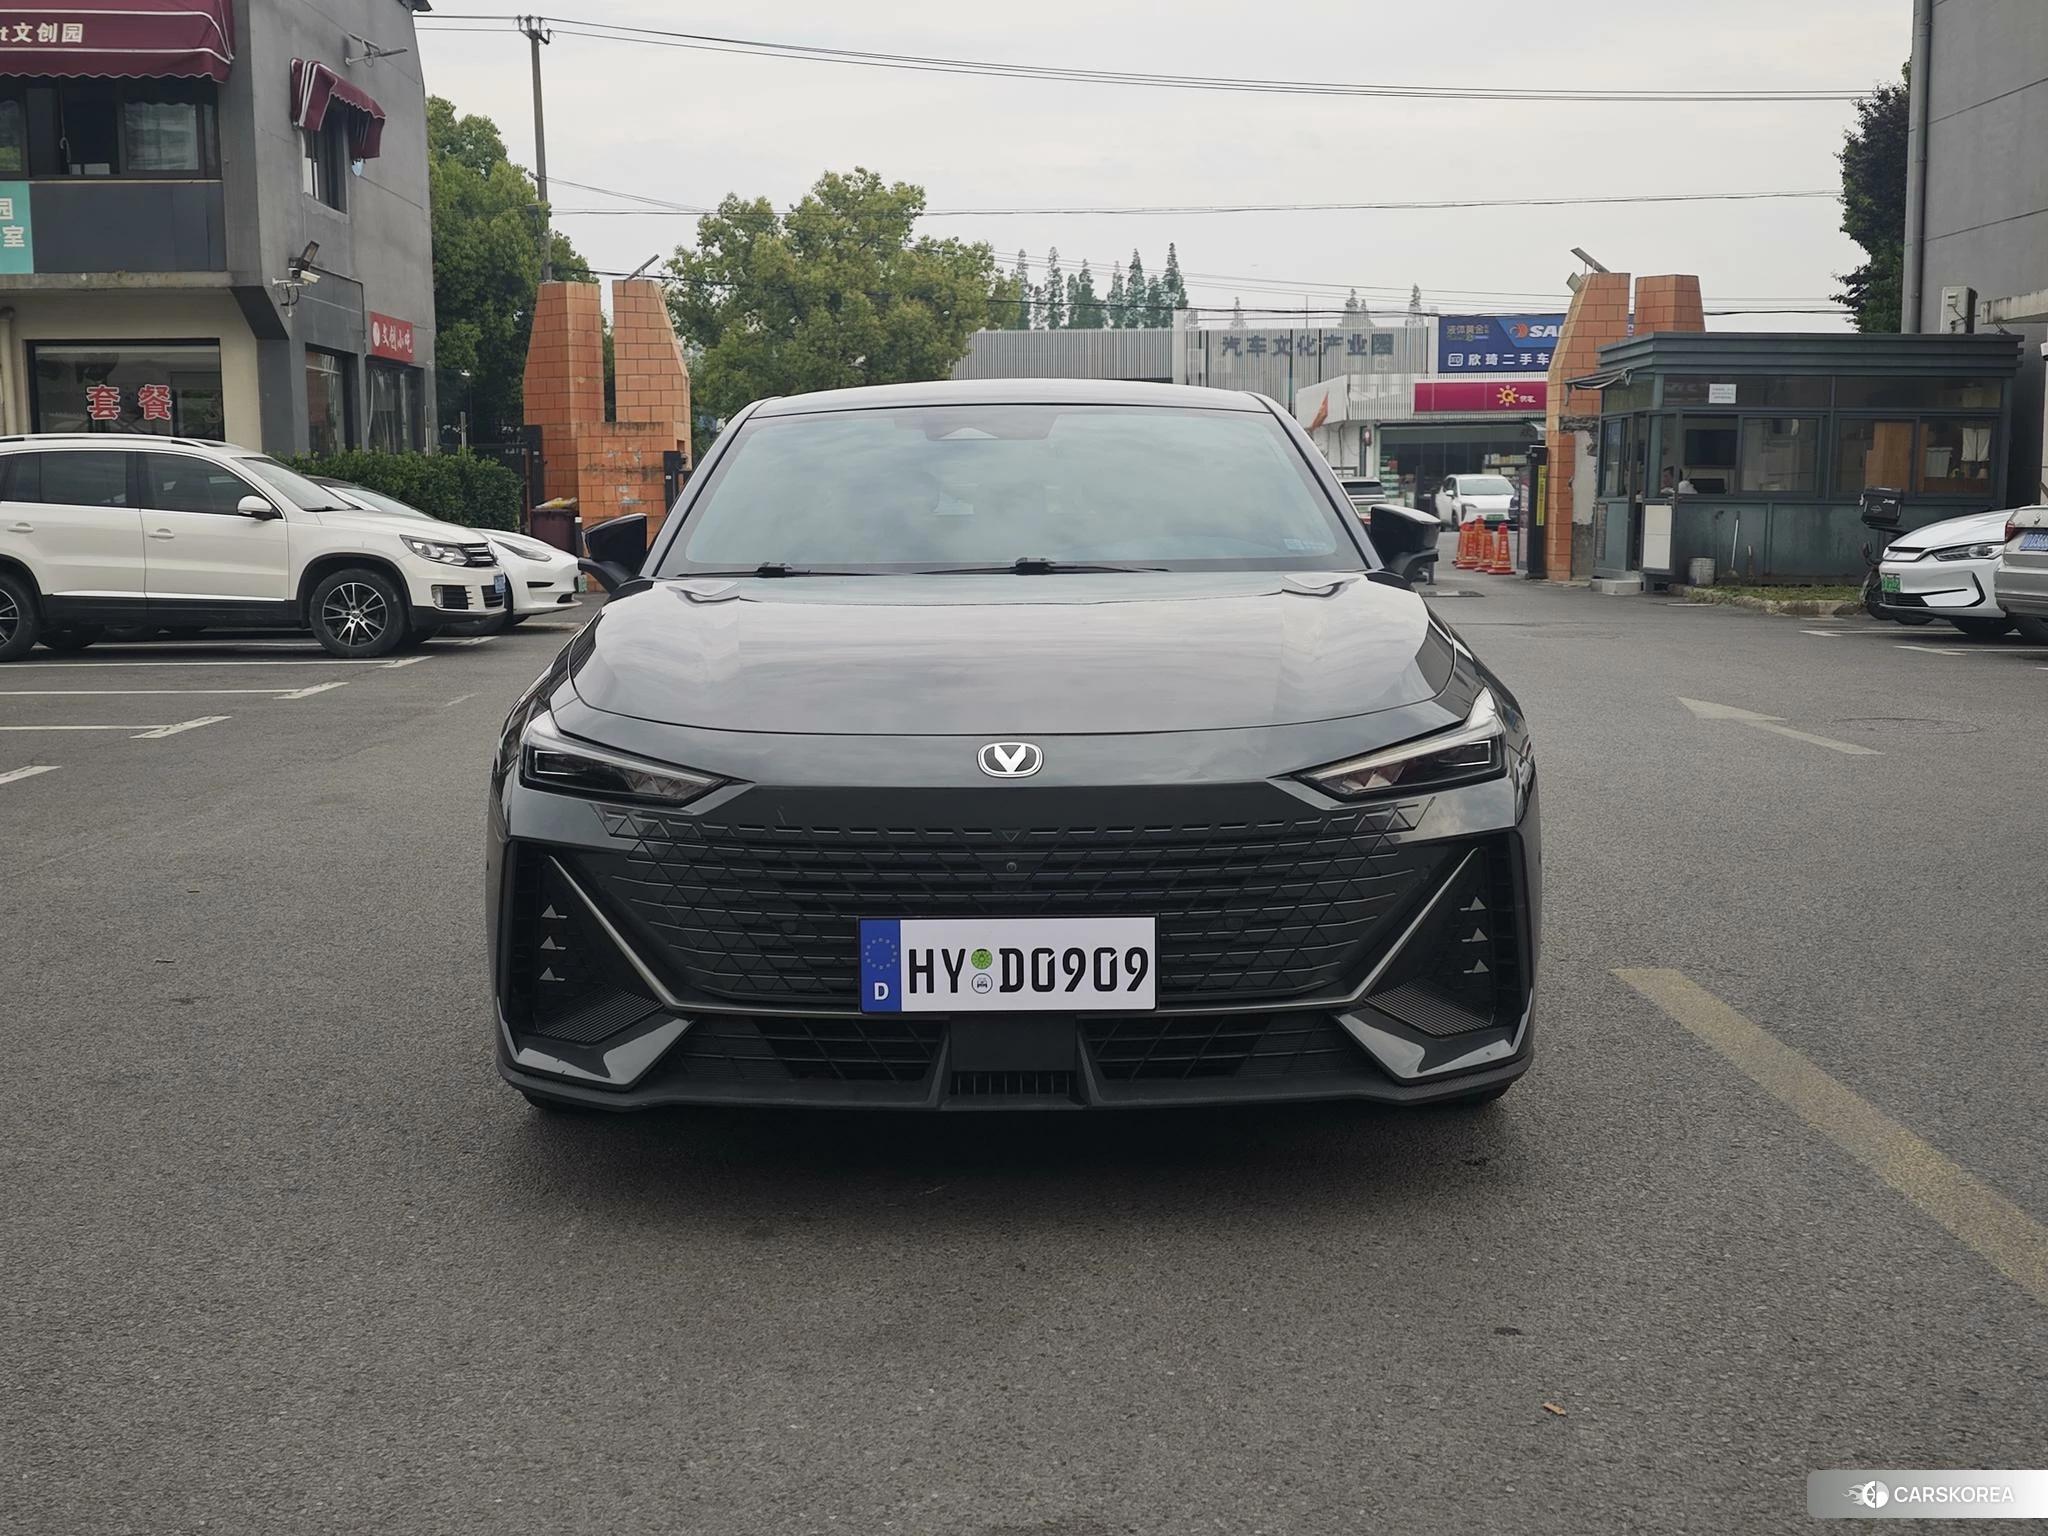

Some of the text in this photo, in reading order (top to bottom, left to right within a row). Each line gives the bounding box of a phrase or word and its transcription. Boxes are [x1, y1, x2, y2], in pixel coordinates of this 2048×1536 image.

[1222, 333, 1394, 358] 汽车文化产业园
[86, 384, 173, 421] 套餐
[874, 947, 1149, 1001] D HY D0909
